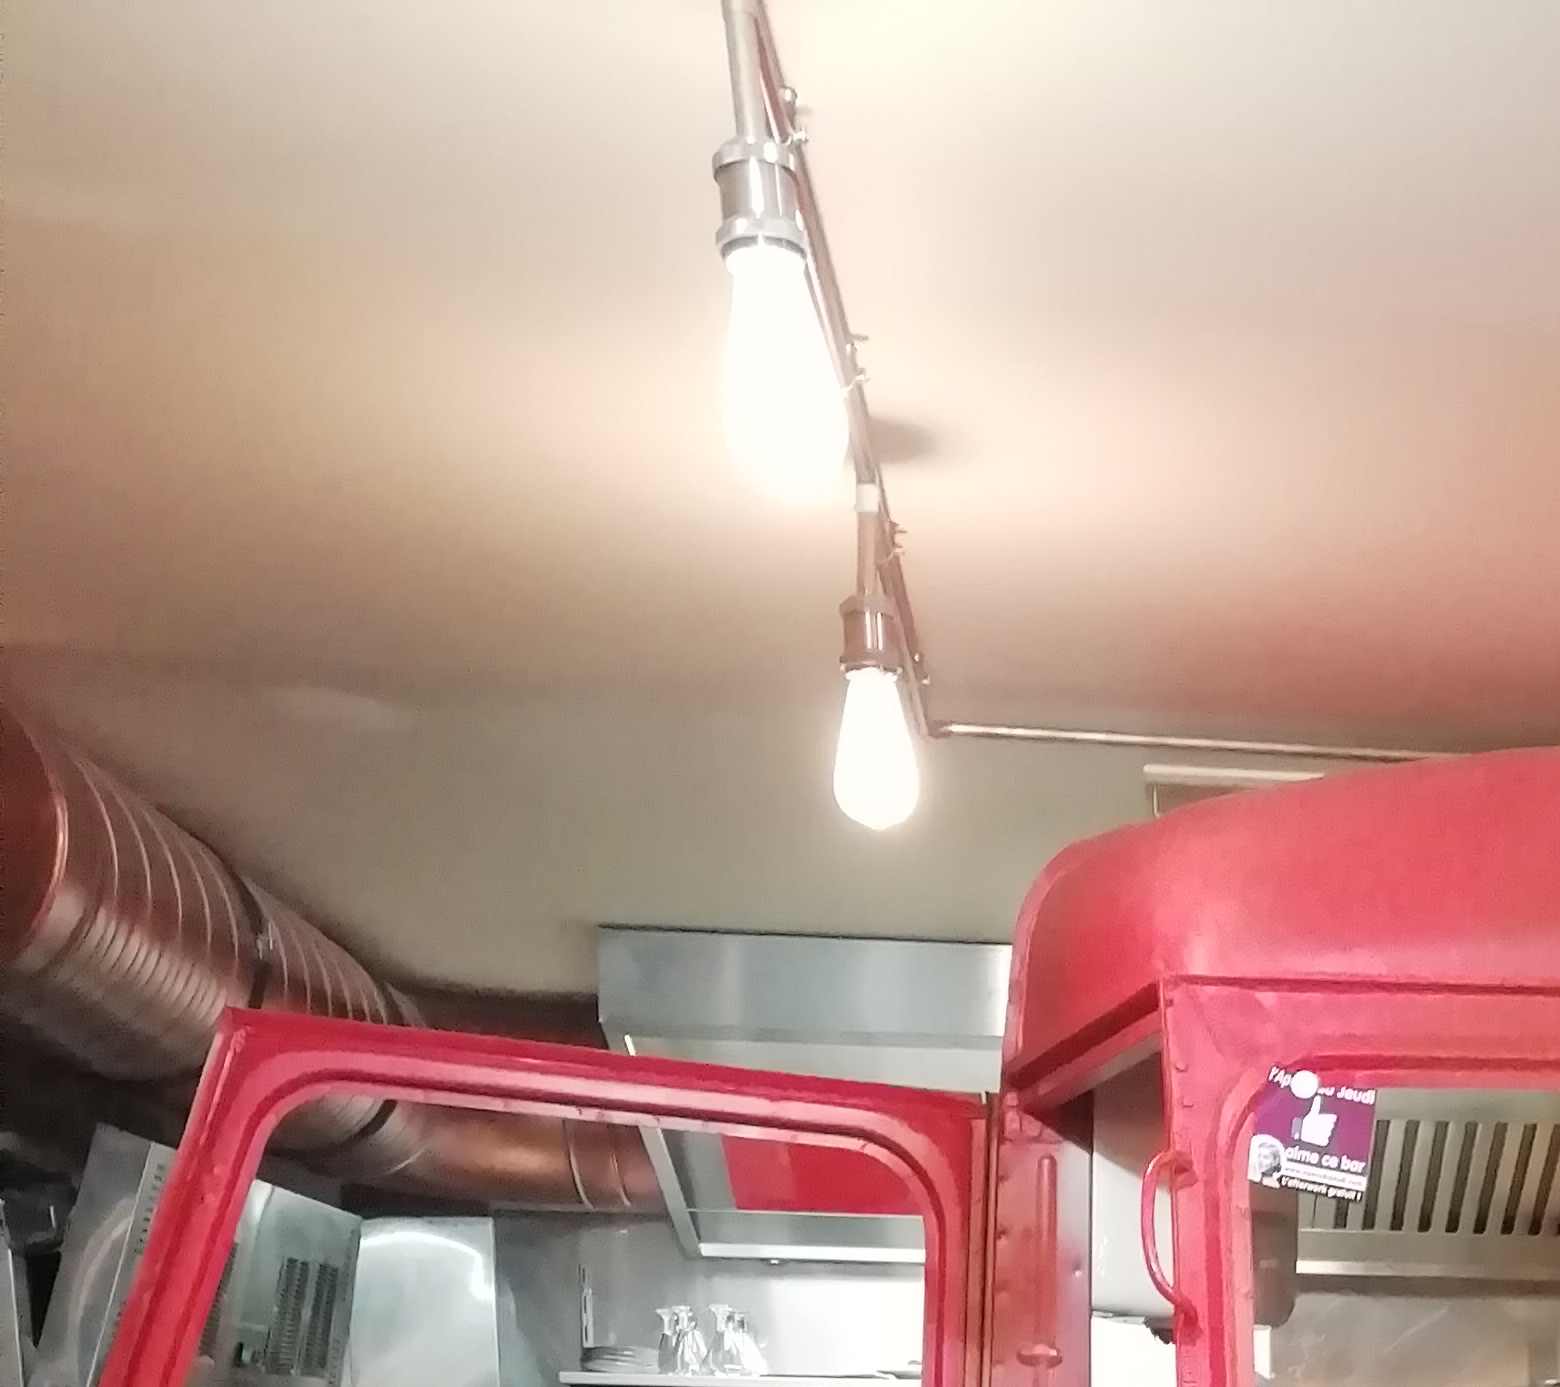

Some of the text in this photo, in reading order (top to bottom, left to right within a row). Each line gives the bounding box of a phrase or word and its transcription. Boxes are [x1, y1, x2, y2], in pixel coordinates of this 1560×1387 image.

[1285, 1145, 1367, 1174] aime ce bar
